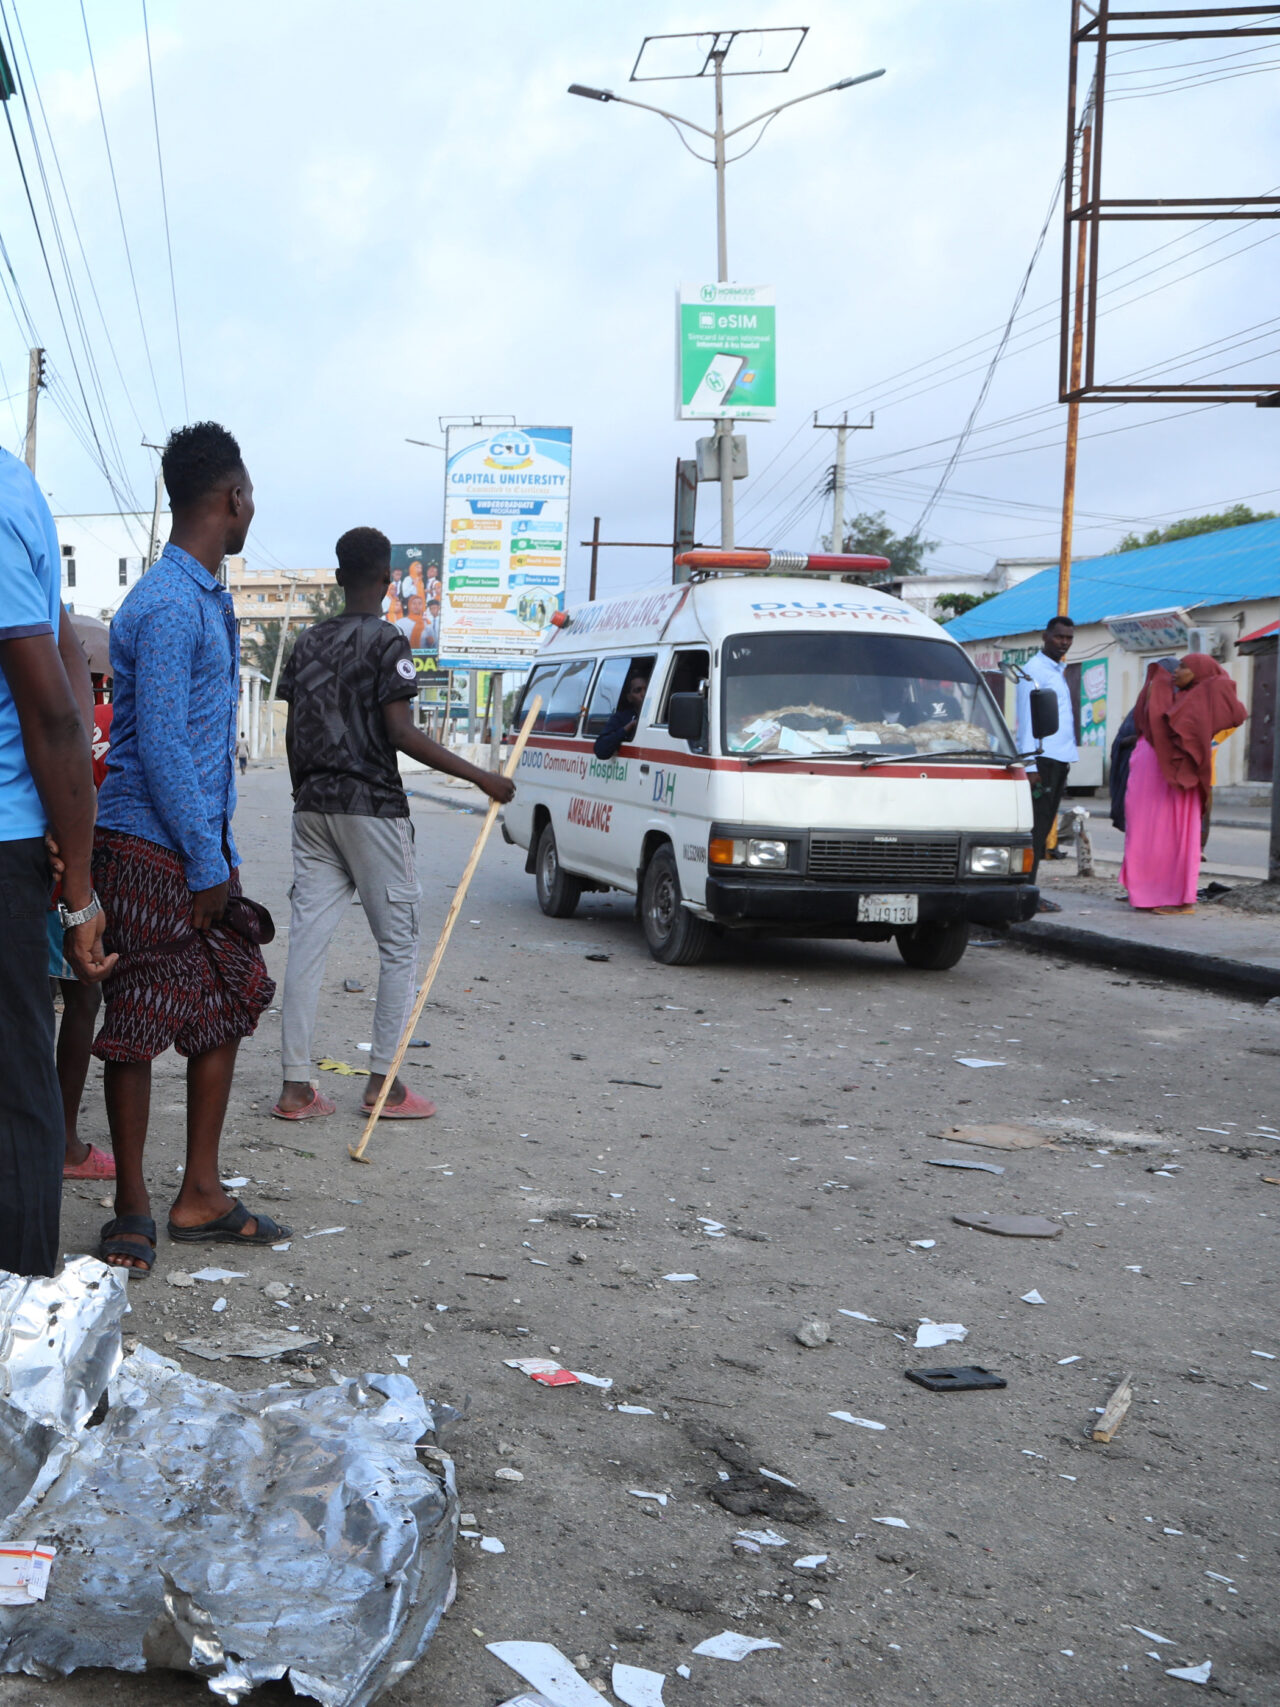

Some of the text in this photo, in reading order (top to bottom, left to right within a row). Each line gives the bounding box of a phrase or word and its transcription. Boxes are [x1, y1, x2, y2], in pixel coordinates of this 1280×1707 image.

[718, 314, 758, 328] eSIM
[451, 473, 566, 486] CAPITAL UNIVERSITY
[594, 592, 675, 632] AMBULANCE
[751, 602, 910, 615] DUCO
[753, 610, 917, 624] HOSPITAL
[413, 657, 439, 673] DA
[521, 750, 629, 783] DUCO Community Hospital
[567, 797, 613, 833] AMBULANCE
